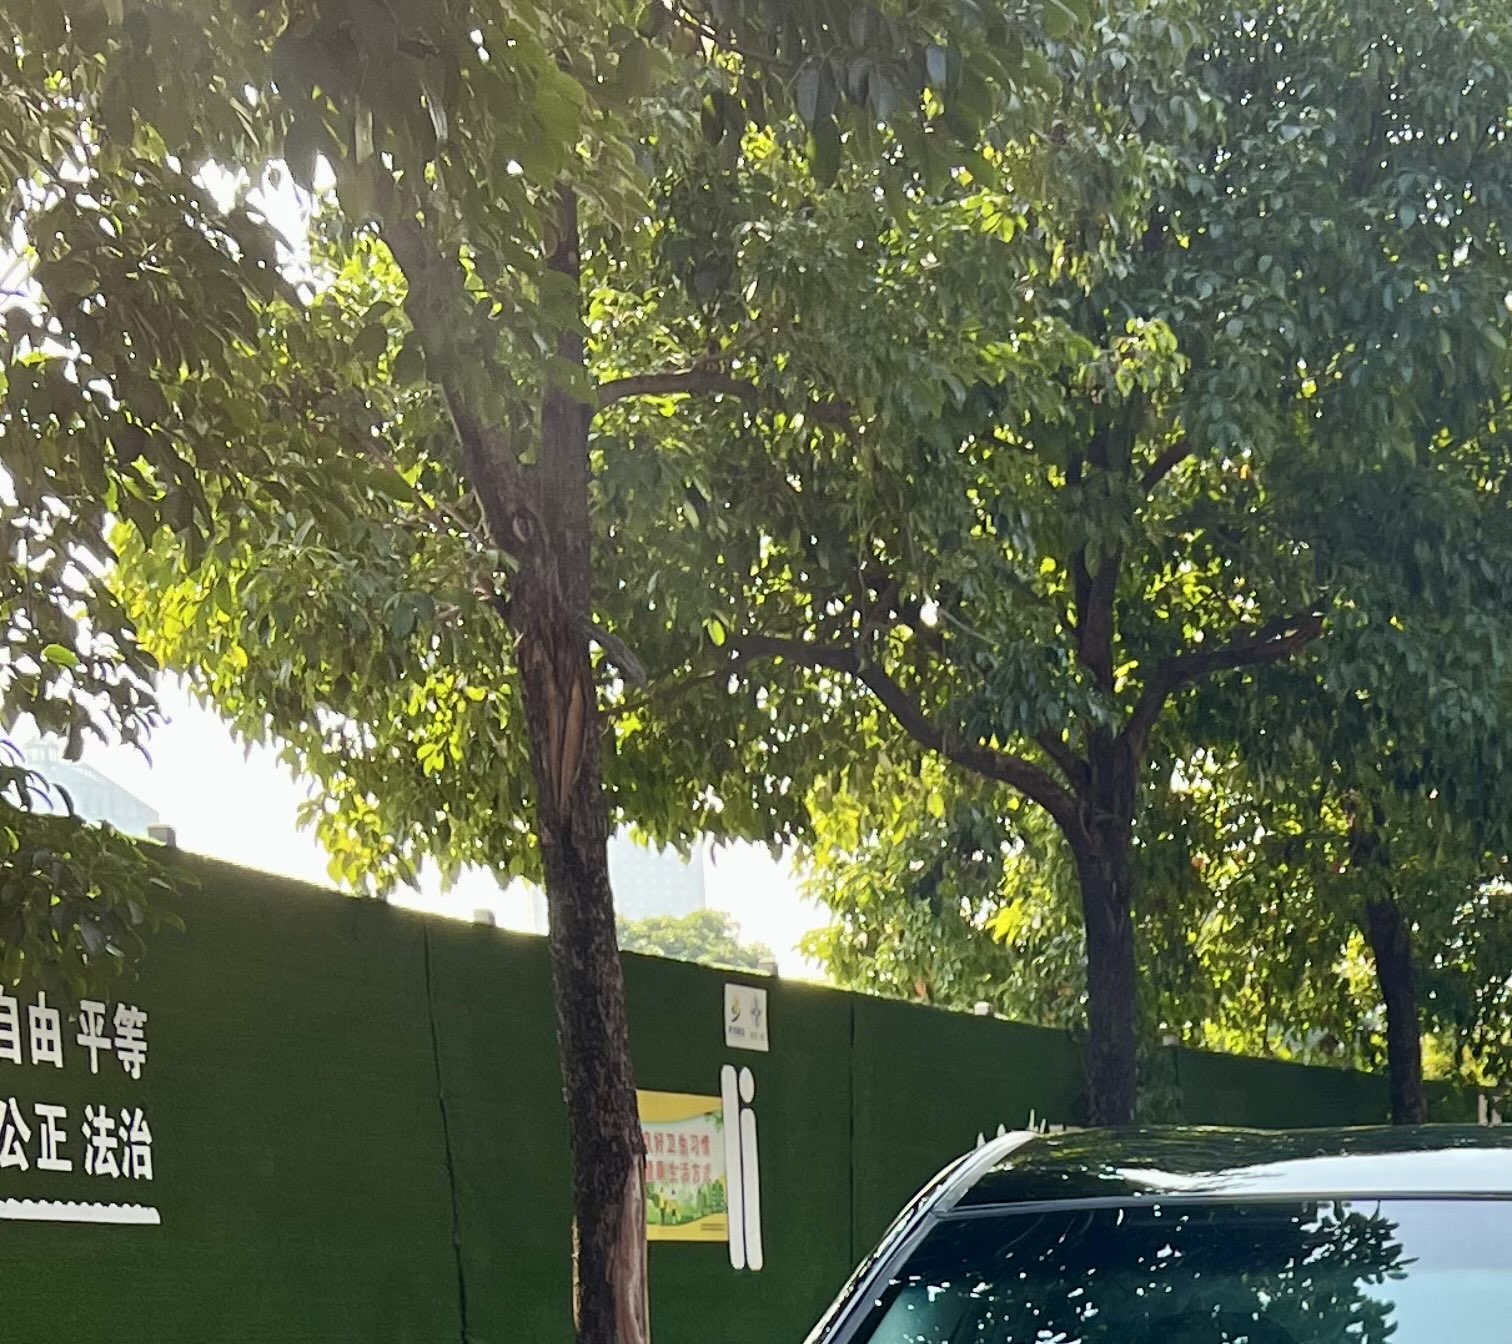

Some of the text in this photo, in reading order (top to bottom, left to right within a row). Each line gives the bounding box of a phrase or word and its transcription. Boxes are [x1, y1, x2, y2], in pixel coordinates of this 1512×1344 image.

[0, 984, 148, 1079] 自由 平等
[0, 1097, 153, 1180] 公正 法治
